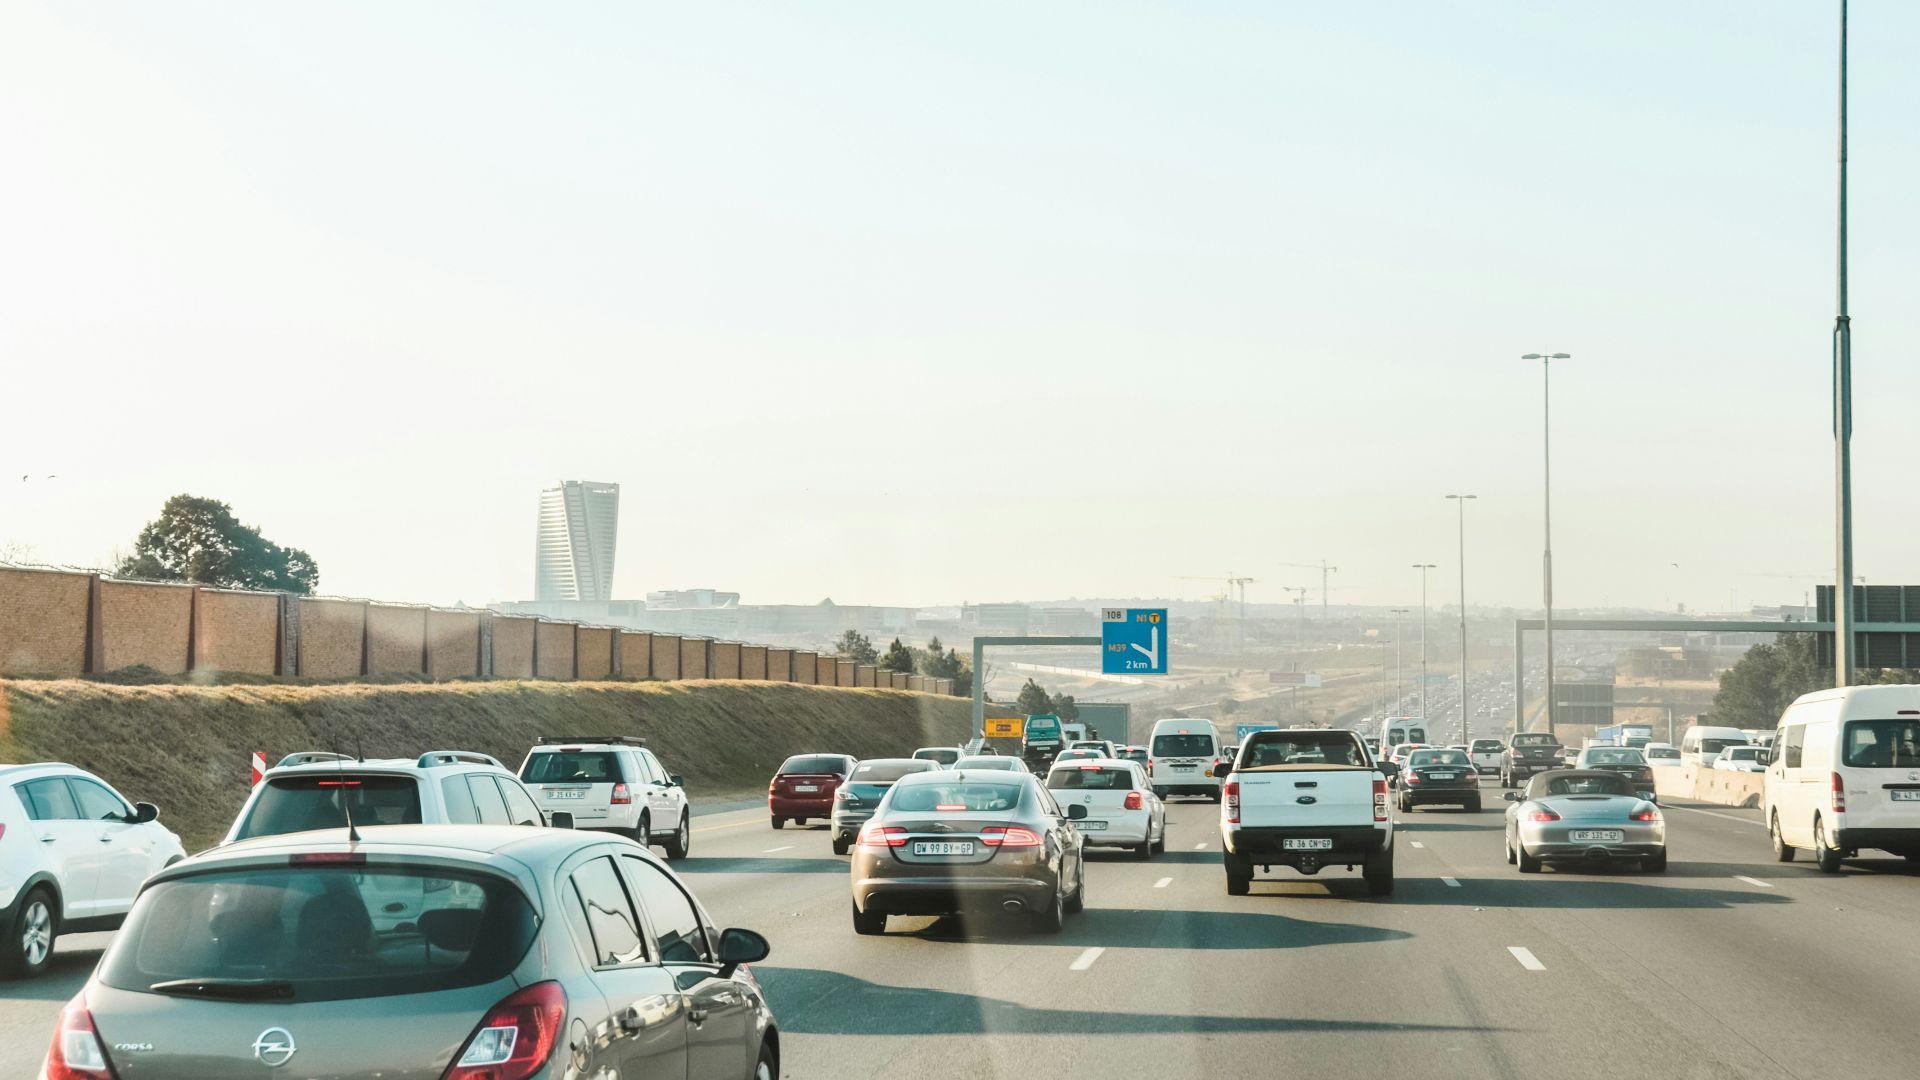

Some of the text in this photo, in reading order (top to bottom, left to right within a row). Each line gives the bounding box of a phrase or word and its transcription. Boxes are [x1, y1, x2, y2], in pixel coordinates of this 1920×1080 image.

[1107, 611, 1121, 619] 108
[1126, 661, 1147, 669] 2 km
[1284, 839, 1331, 848] FR 36 CN GP
[916, 843, 972, 853] DW 99 BY GP
[114, 1042, 153, 1050] CORSA
